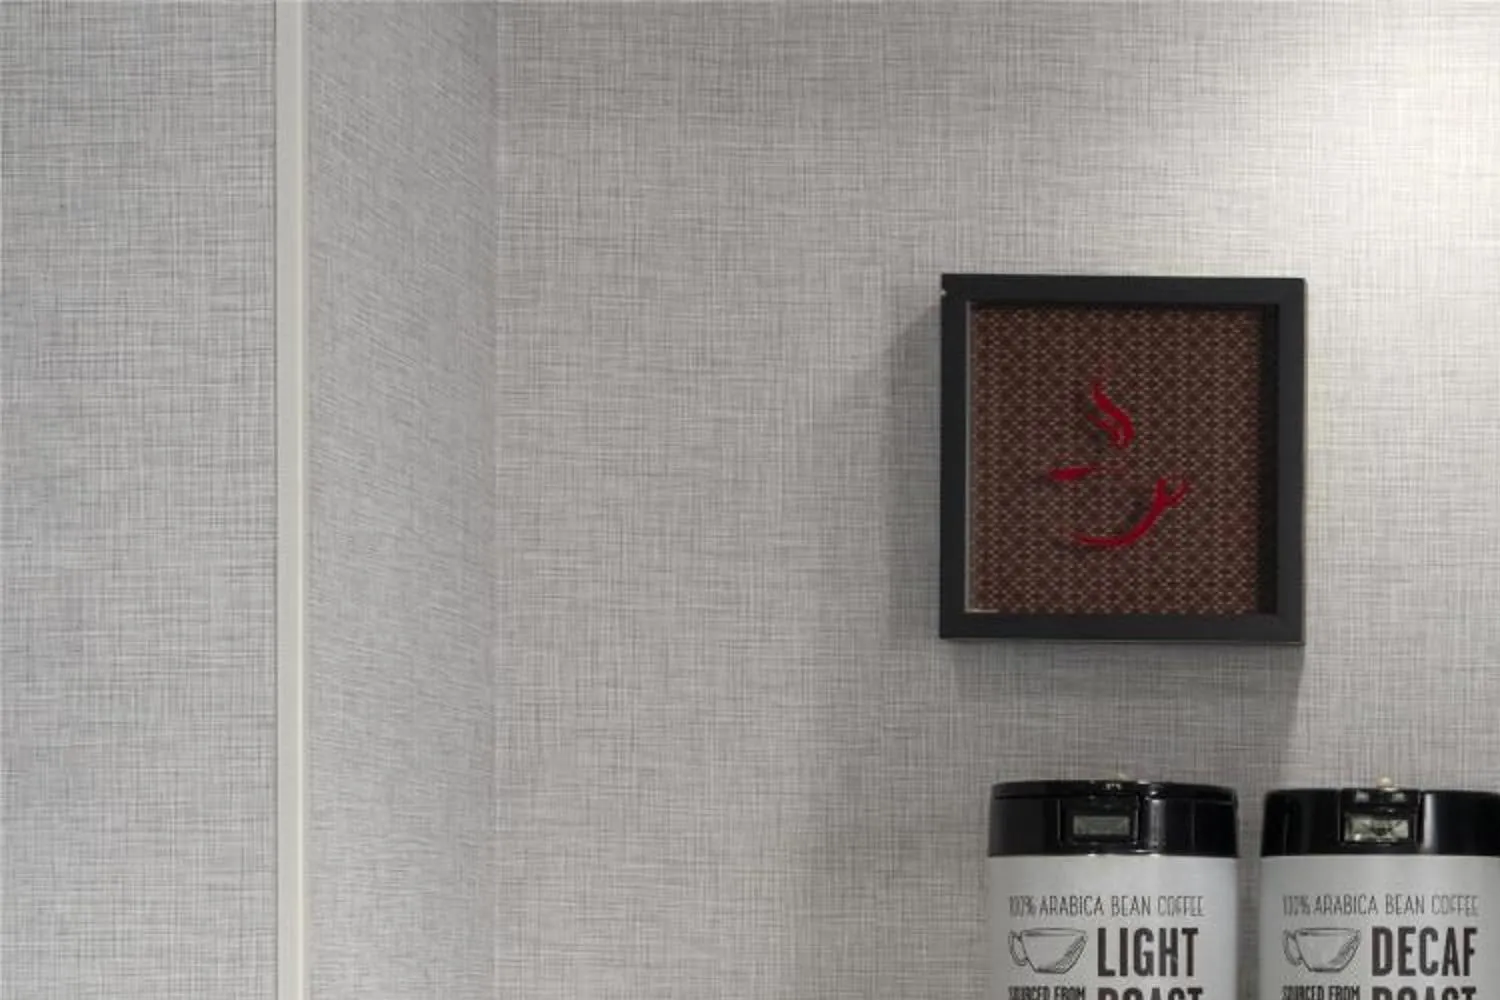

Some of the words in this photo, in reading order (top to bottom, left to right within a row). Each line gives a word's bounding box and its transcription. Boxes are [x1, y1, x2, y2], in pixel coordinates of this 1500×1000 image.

[1039, 896, 1104, 917] ARABICA
[1110, 896, 1151, 917] BEAN
[1157, 895, 1205, 917] COFFEE
[1313, 895, 1378, 915] ARABICA
[1385, 895, 1425, 915] BEAN
[1431, 895, 1479, 916] COFFEE
[1097, 927, 1199, 977] LIGHT
[1372, 926, 1477, 976] DECAF
